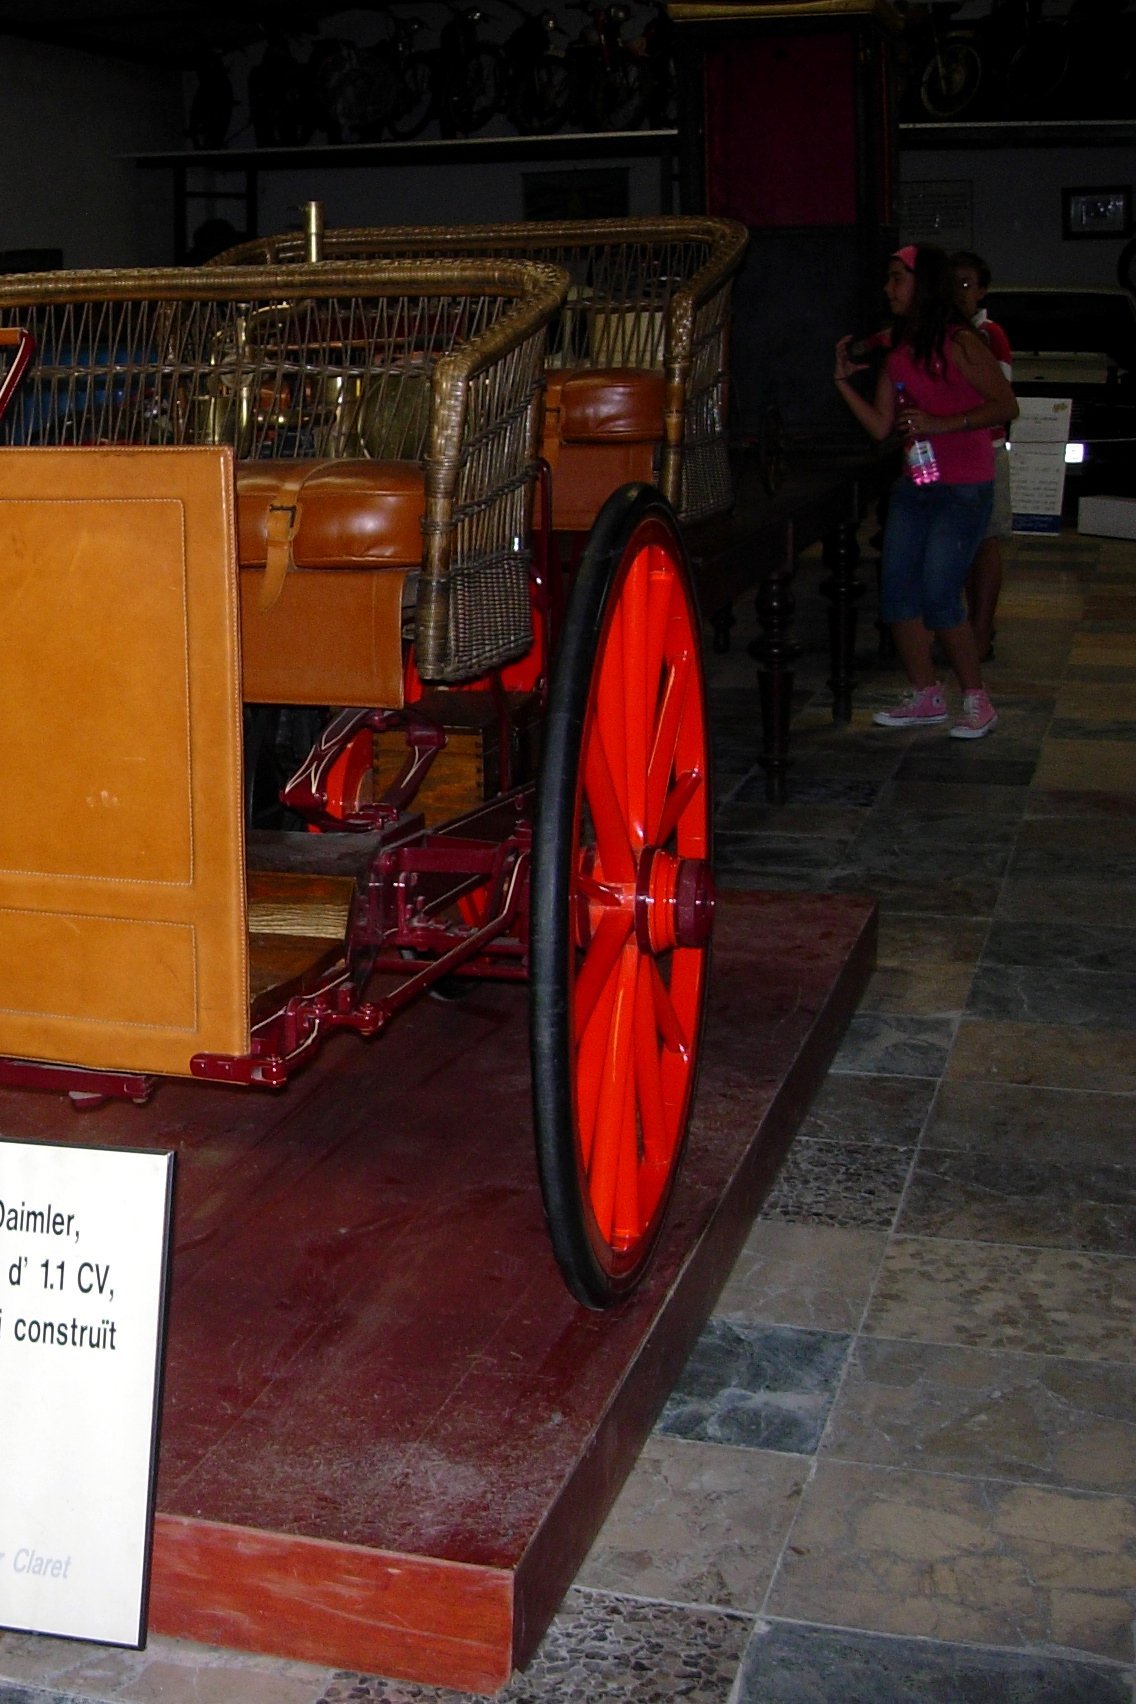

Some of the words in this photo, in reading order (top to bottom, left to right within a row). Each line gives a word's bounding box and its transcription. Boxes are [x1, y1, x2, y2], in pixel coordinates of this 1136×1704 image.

[40, 1258, 65, 1291] 1.1
[77, 1262, 114, 1303] CV,
[14, 1317, 117, 1351] construït
[14, 1549, 71, 1579] Claret
